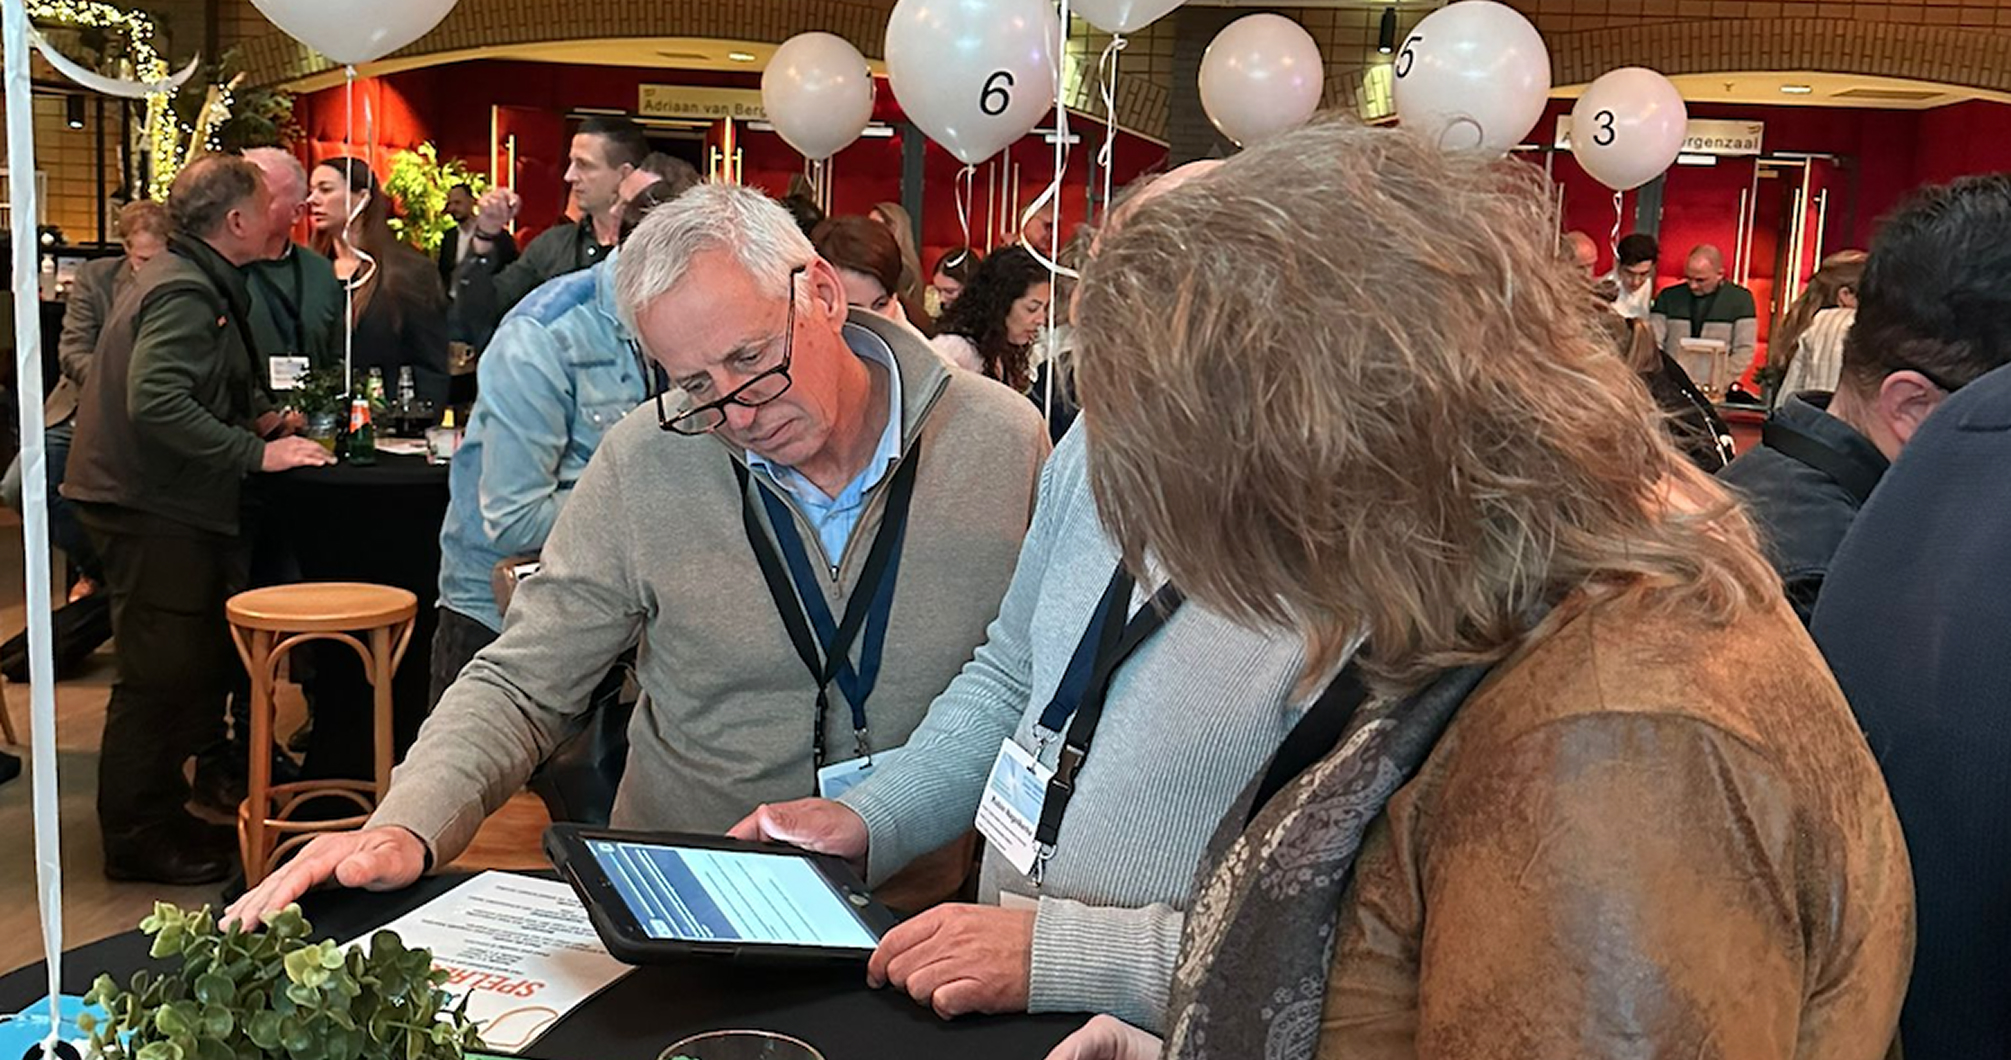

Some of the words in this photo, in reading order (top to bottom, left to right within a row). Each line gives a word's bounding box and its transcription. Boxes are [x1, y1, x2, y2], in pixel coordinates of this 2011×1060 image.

[1396, 36, 1422, 78] 5
[644, 99, 699, 113] Adriaan
[703, 105, 730, 115] van
[980, 71, 1014, 115] 6
[1593, 110, 1615, 146] 3
[1683, 136, 1759, 149] rgenzaal
